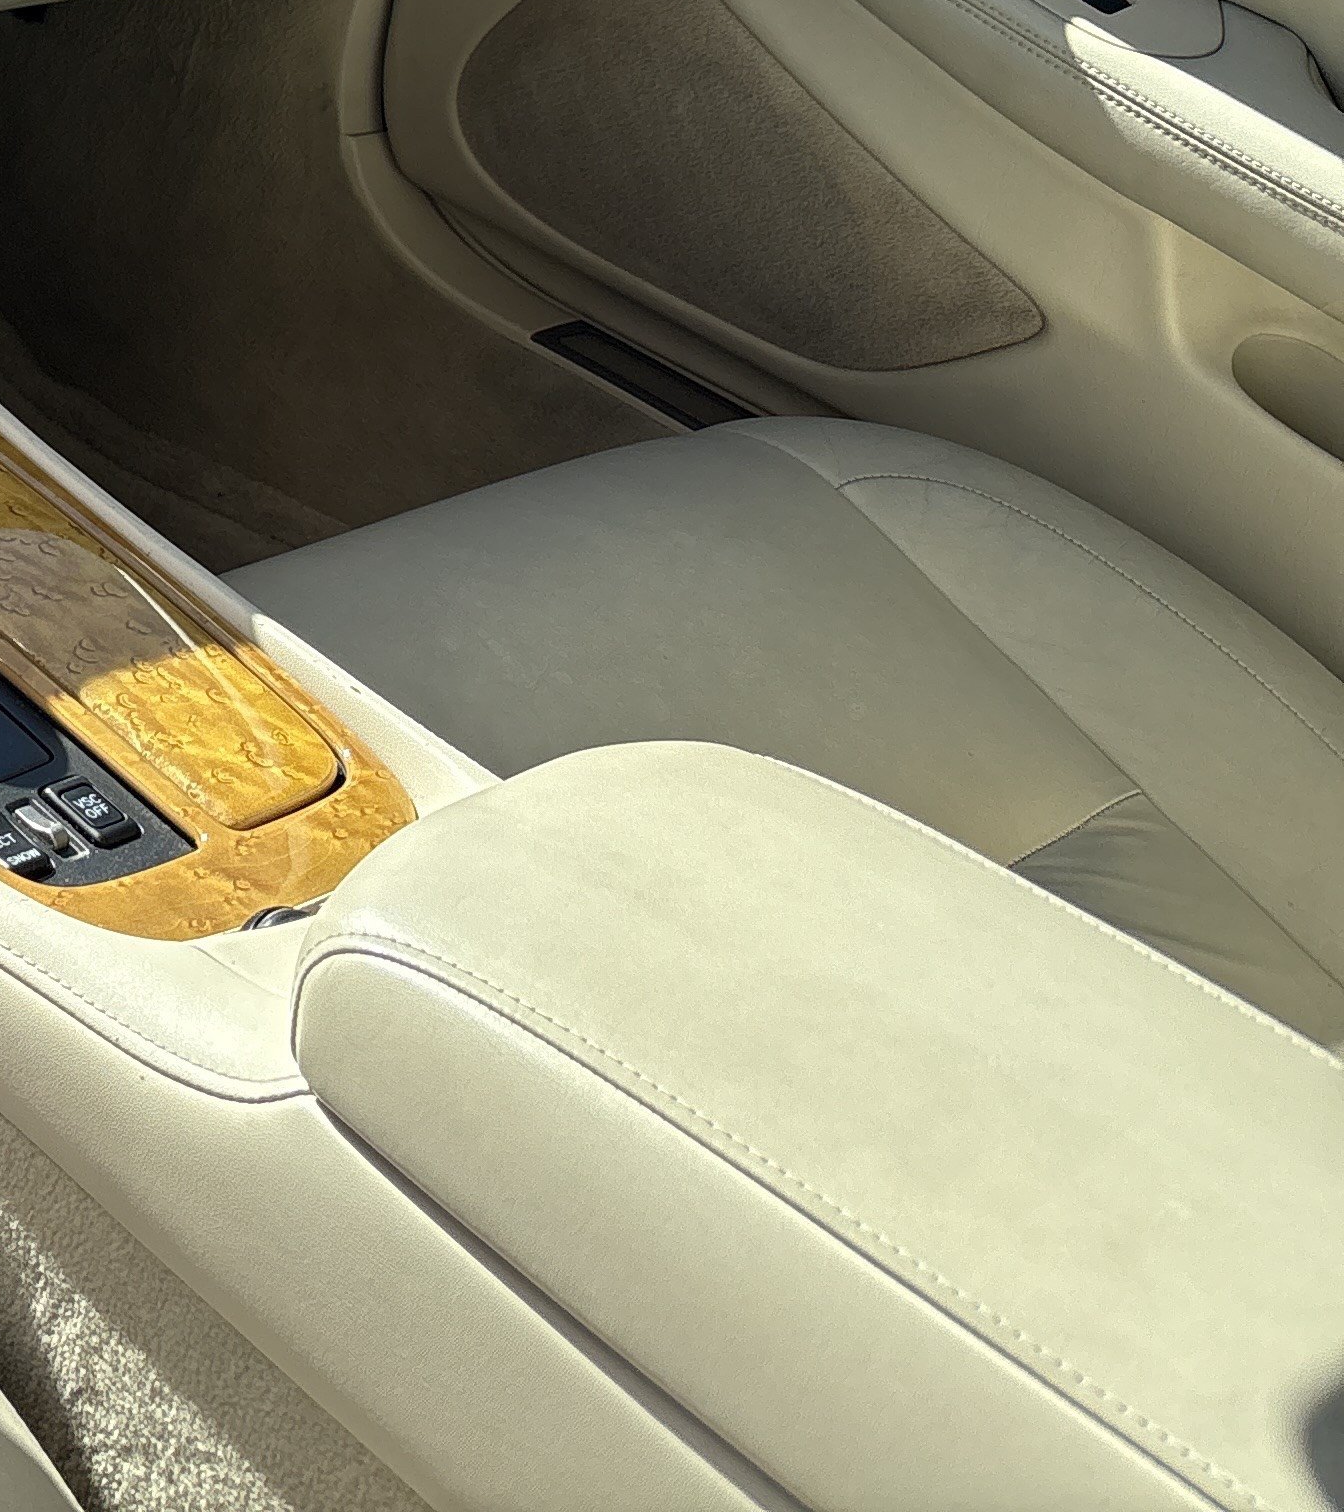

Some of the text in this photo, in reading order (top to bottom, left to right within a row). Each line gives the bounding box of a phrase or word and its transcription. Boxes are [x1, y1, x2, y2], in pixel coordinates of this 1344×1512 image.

[73, 793, 102, 810] VSC
[85, 803, 110, 820] OFF
[6, 848, 42, 866] SNOW
